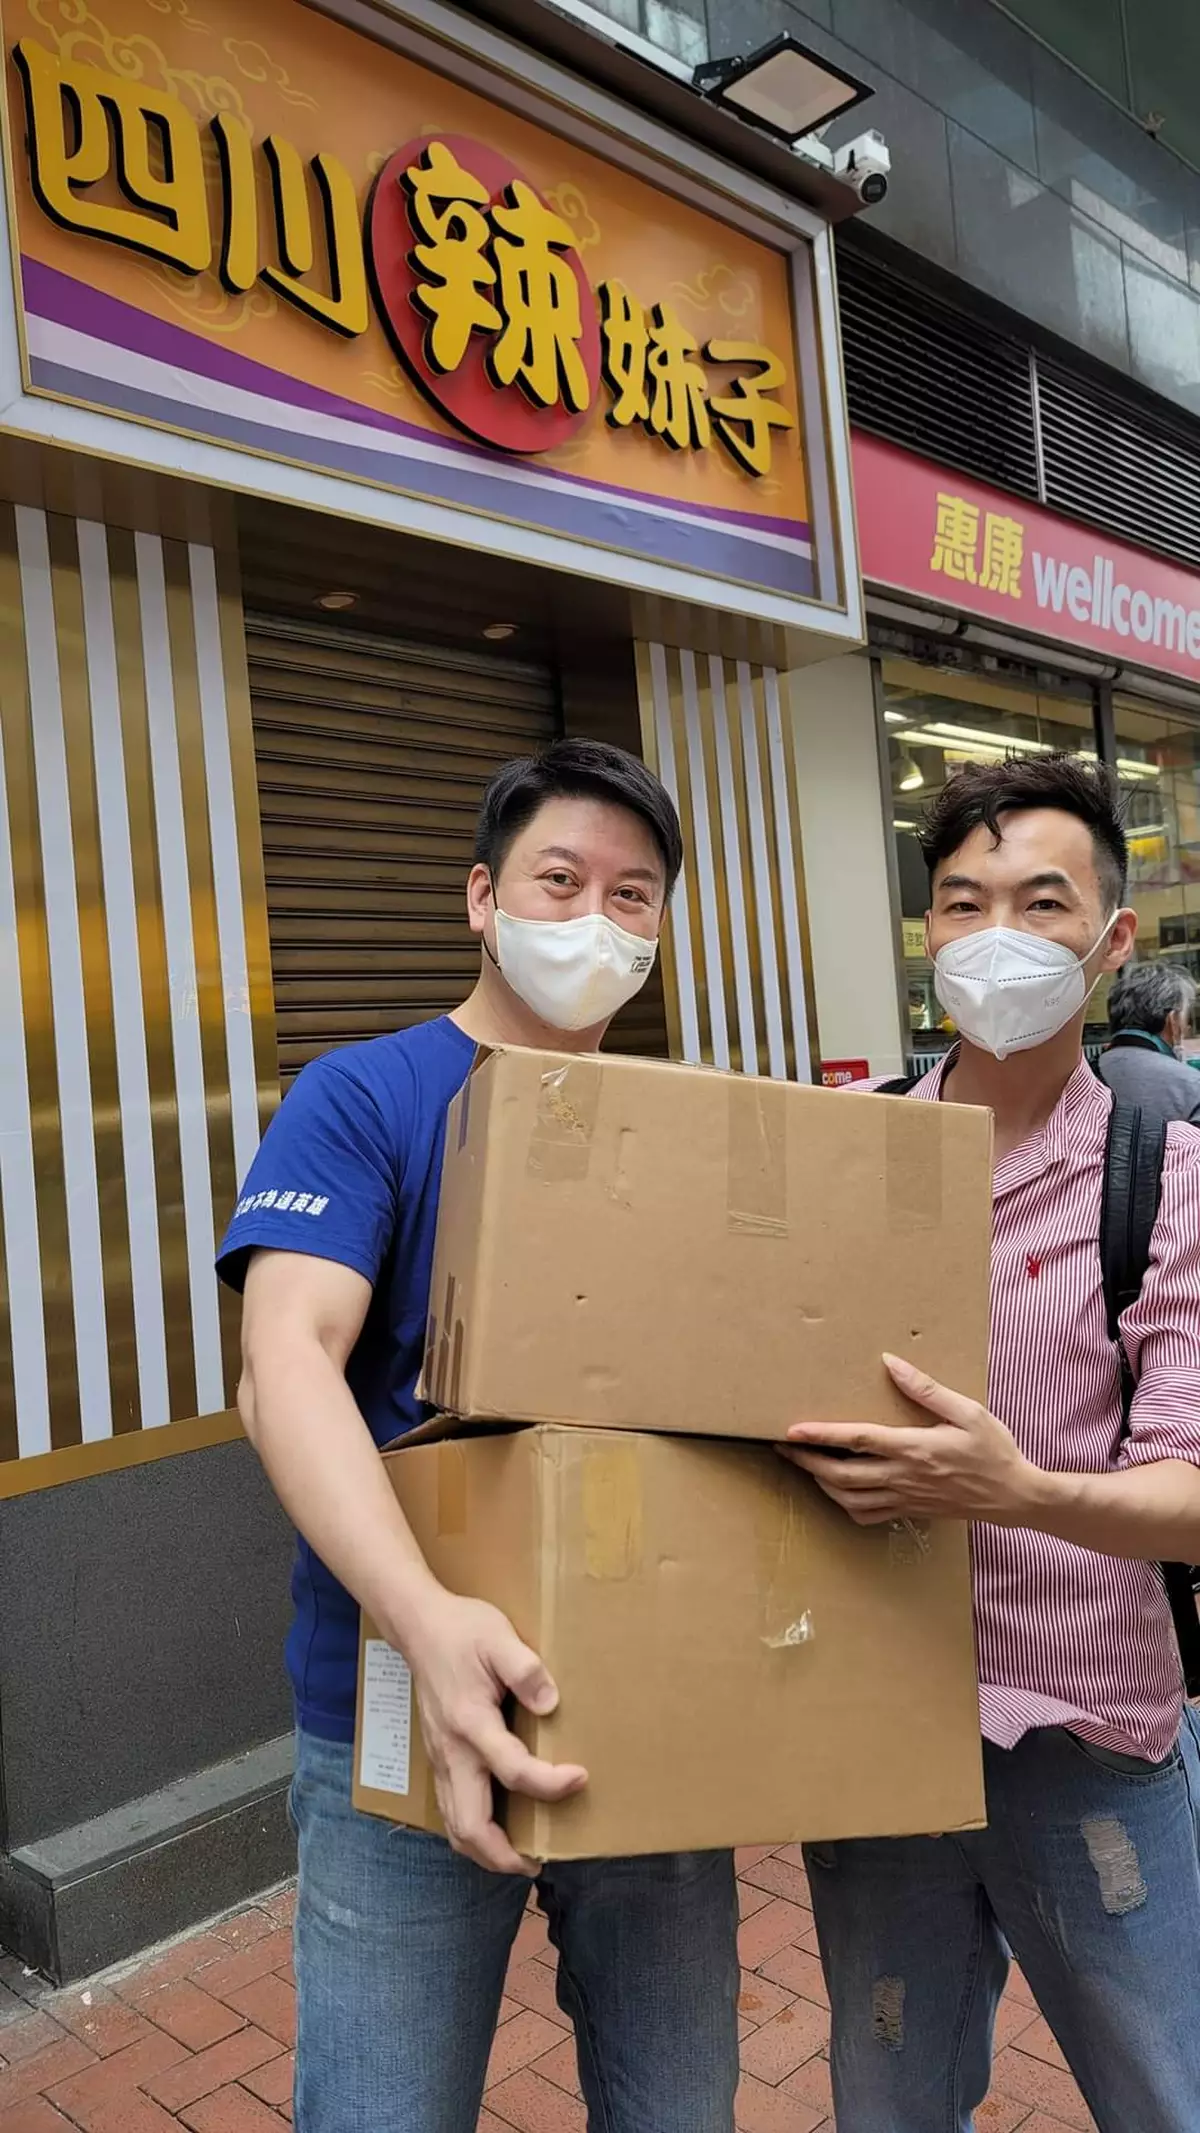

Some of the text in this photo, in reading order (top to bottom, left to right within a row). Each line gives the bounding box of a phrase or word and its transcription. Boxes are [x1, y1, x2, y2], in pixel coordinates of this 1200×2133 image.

[13, 38, 795, 478] 四川辣妹子
[930, 492, 1024, 599] 惠康
[1032, 551, 1200, 660] wellcome
